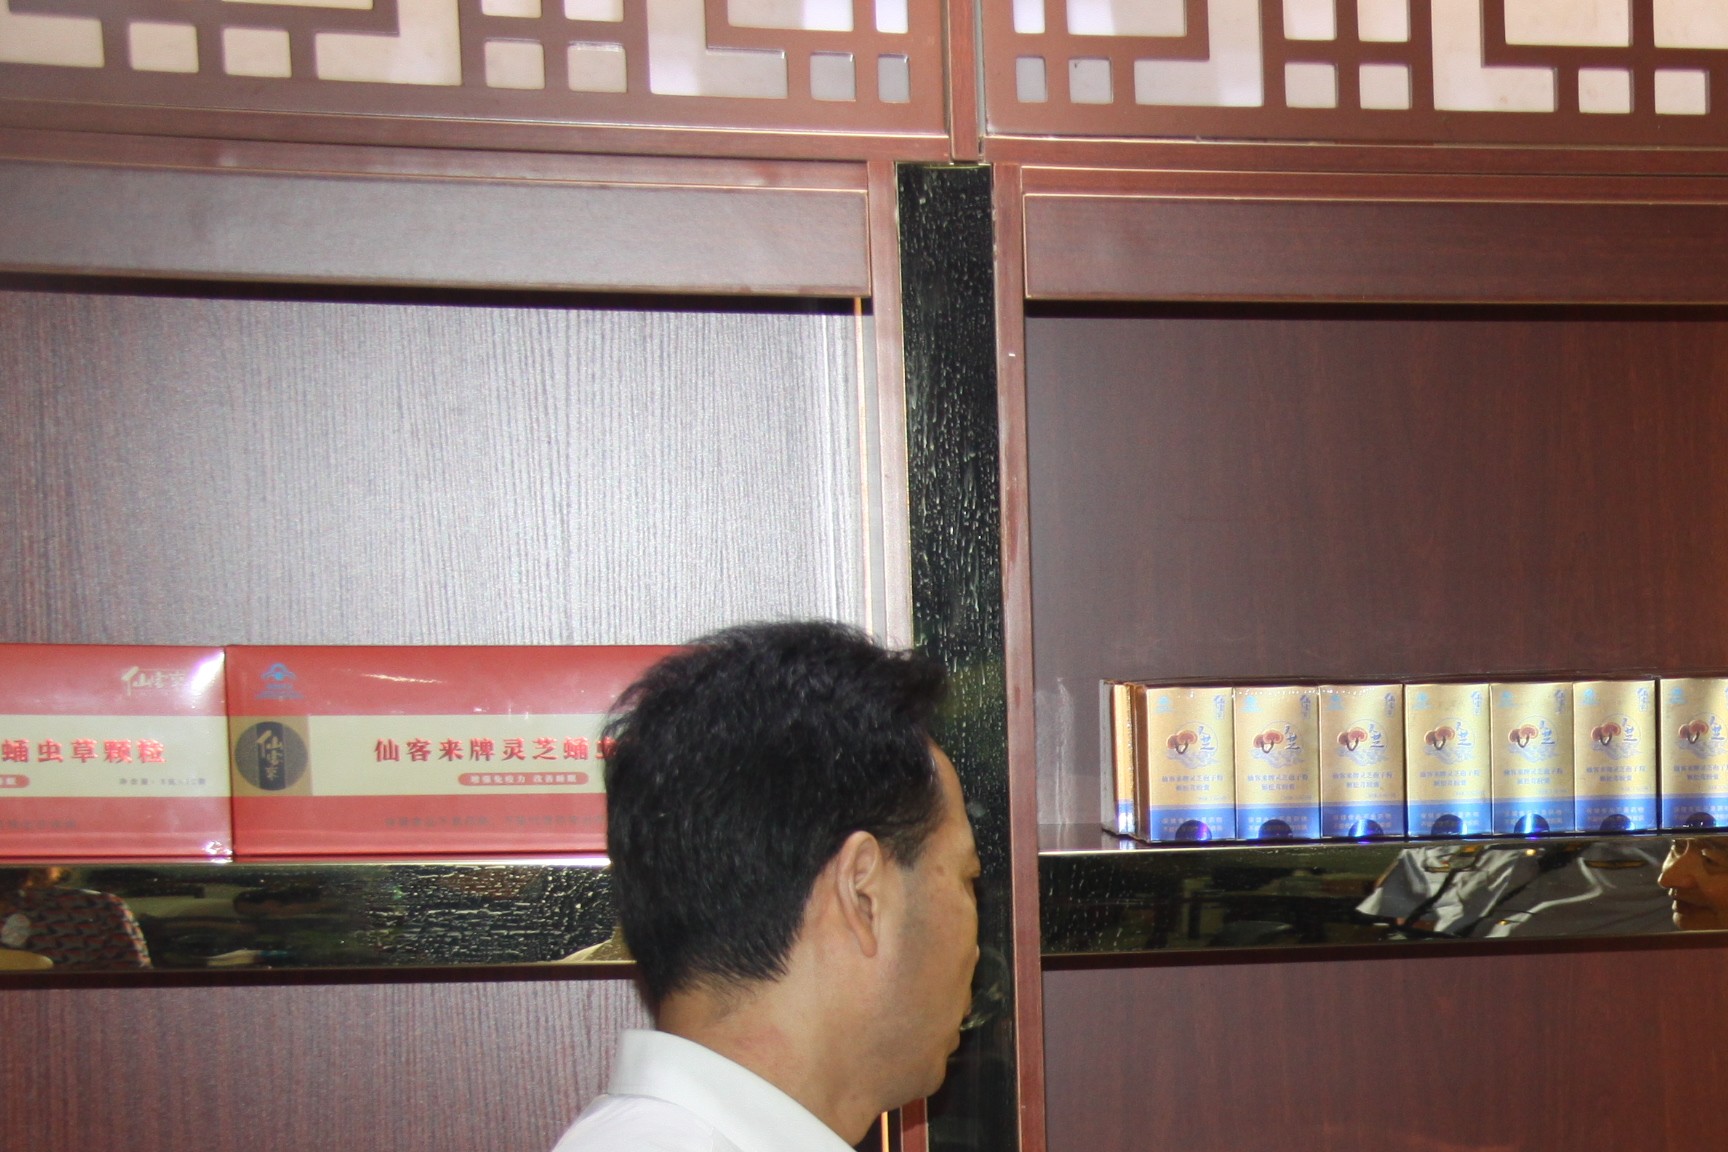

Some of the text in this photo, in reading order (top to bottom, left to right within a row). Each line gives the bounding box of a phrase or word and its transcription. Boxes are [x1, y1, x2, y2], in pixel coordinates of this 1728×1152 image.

[1, 738, 167, 764] 蛹虫草颗粒
